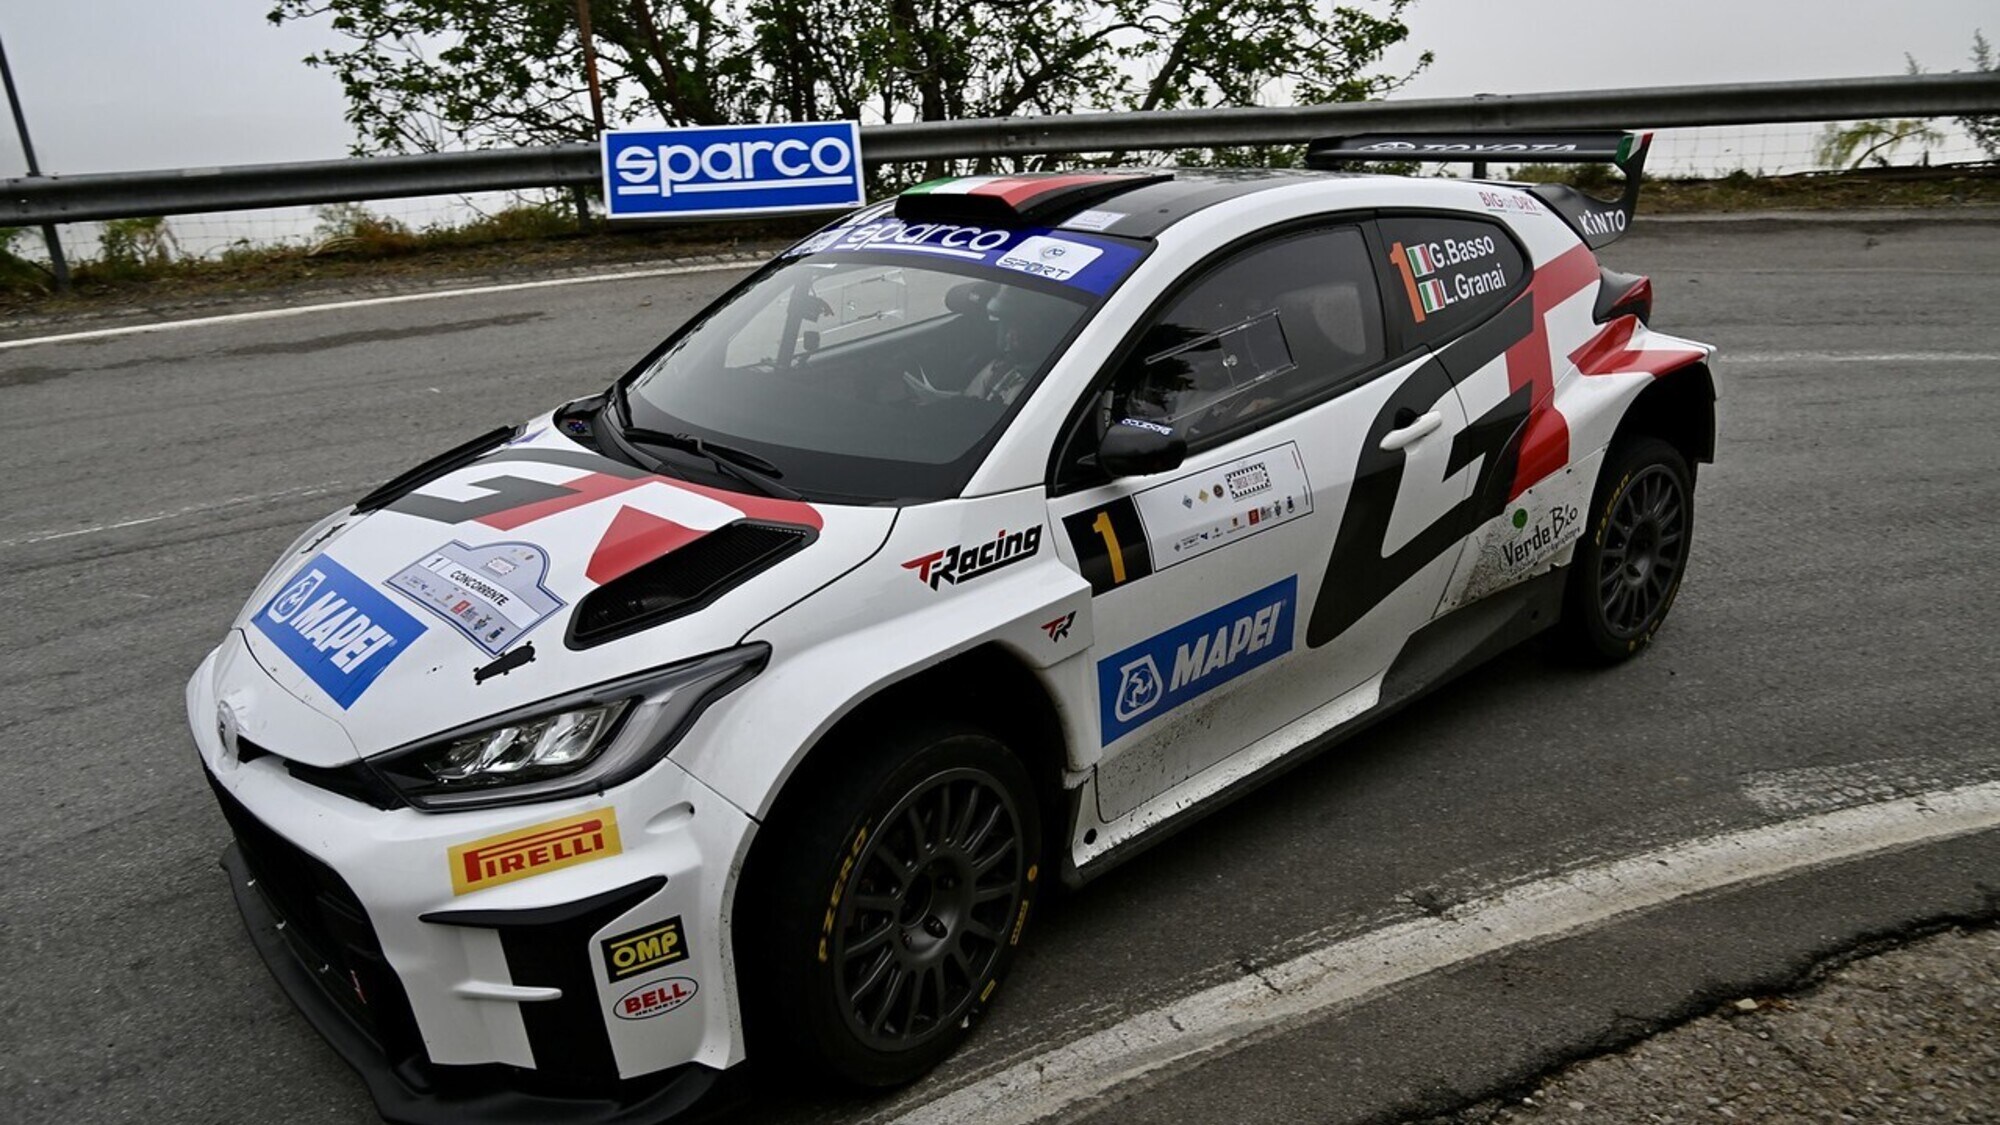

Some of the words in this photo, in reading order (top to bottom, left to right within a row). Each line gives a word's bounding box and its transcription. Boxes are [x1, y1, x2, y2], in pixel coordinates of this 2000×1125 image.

[615, 136, 852, 197] sparco
[846, 220, 1011, 256] sparco
[1428, 235, 1495, 269] G.Basso
[1002, 257, 1070, 279] SPORT
[1389, 241, 1426, 323] 1
[1439, 262, 1507, 305] L.Granai
[1092, 510, 1127, 584] 1
[1502, 525, 1551, 567] Verde
[1550, 504, 1579, 539] Bio
[449, 569, 510, 607] CONCORRENTE
[289, 589, 396, 675] MAPEI
[1169, 600, 1282, 693] MAPEI
[463, 818, 604, 884] PIRELLI
[612, 931, 679, 968] OMP
[624, 983, 688, 1014] BELL
